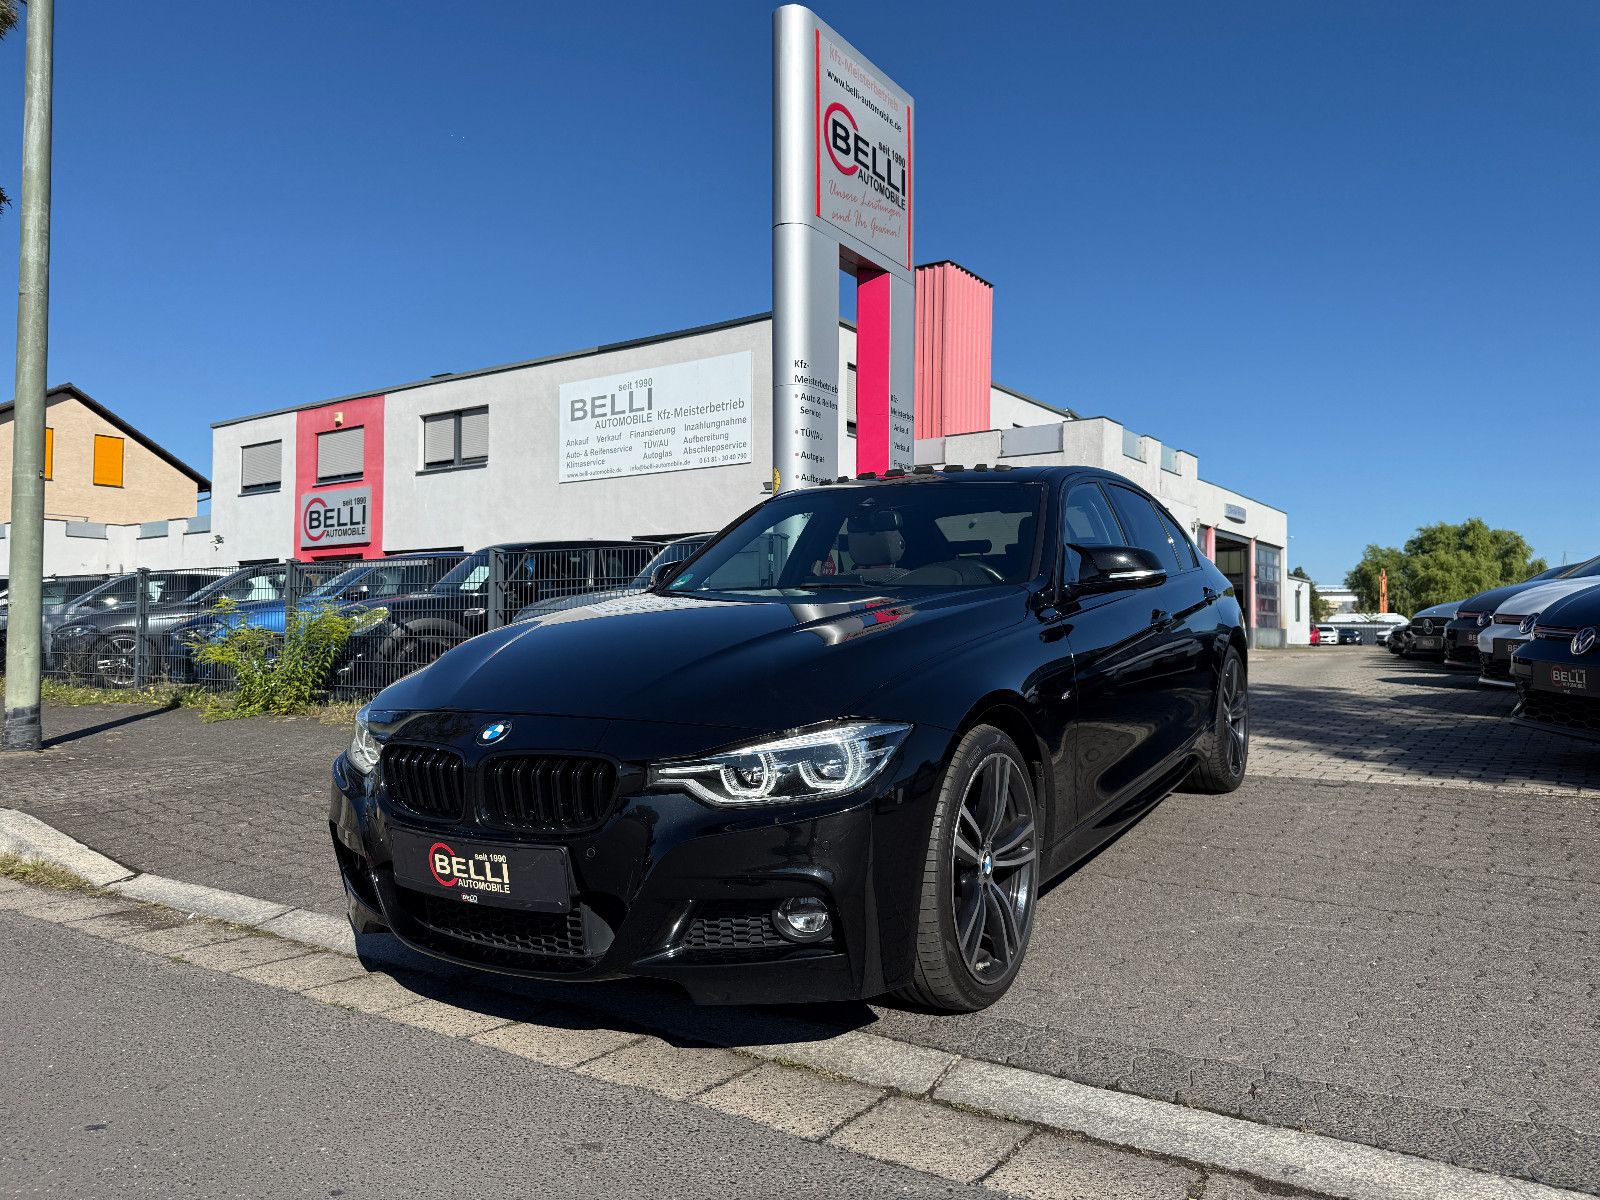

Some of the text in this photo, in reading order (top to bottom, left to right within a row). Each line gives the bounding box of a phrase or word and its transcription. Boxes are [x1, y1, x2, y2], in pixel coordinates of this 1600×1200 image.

[829, 45, 899, 112] Kfz-Meisterbetrieb
[826, 68, 902, 133] www.belli-automobile.de
[832, 117, 906, 197] BELLI
[878, 141, 906, 168] seit 1990
[828, 179, 858, 203] Unsere
[857, 168, 906, 211] AUTOMOBILE
[794, 359, 810, 369] Kfz-
[618, 377, 653, 392] seit 1990
[794, 374, 839, 394] Meisterbetrieb
[570, 387, 653, 422] BELLI
[594, 397, 745, 430] AUTOMOBILE Kfz-Meisterbetrieb
[565, 416, 747, 448] Ankauf Verkauf Finanzierung Inzahlungnahme
[589, 445, 633, 457] Reifenservice
[643, 438, 669, 450] TÜV/AU
[683, 432, 729, 445] Aufbereitung
[566, 440, 747, 469] Klimaservice Autoglas Abschleppservice
[342, 496, 367, 507] seit 1990
[308, 504, 367, 530] BELLI
[325, 526, 366, 538] AUTOMOBILE
[1552, 670, 1586, 684] BELLI
[434, 853, 510, 884] BELLI
[474, 852, 507, 863] seit 1990
[457, 878, 511, 894] AUTOMOBILE
